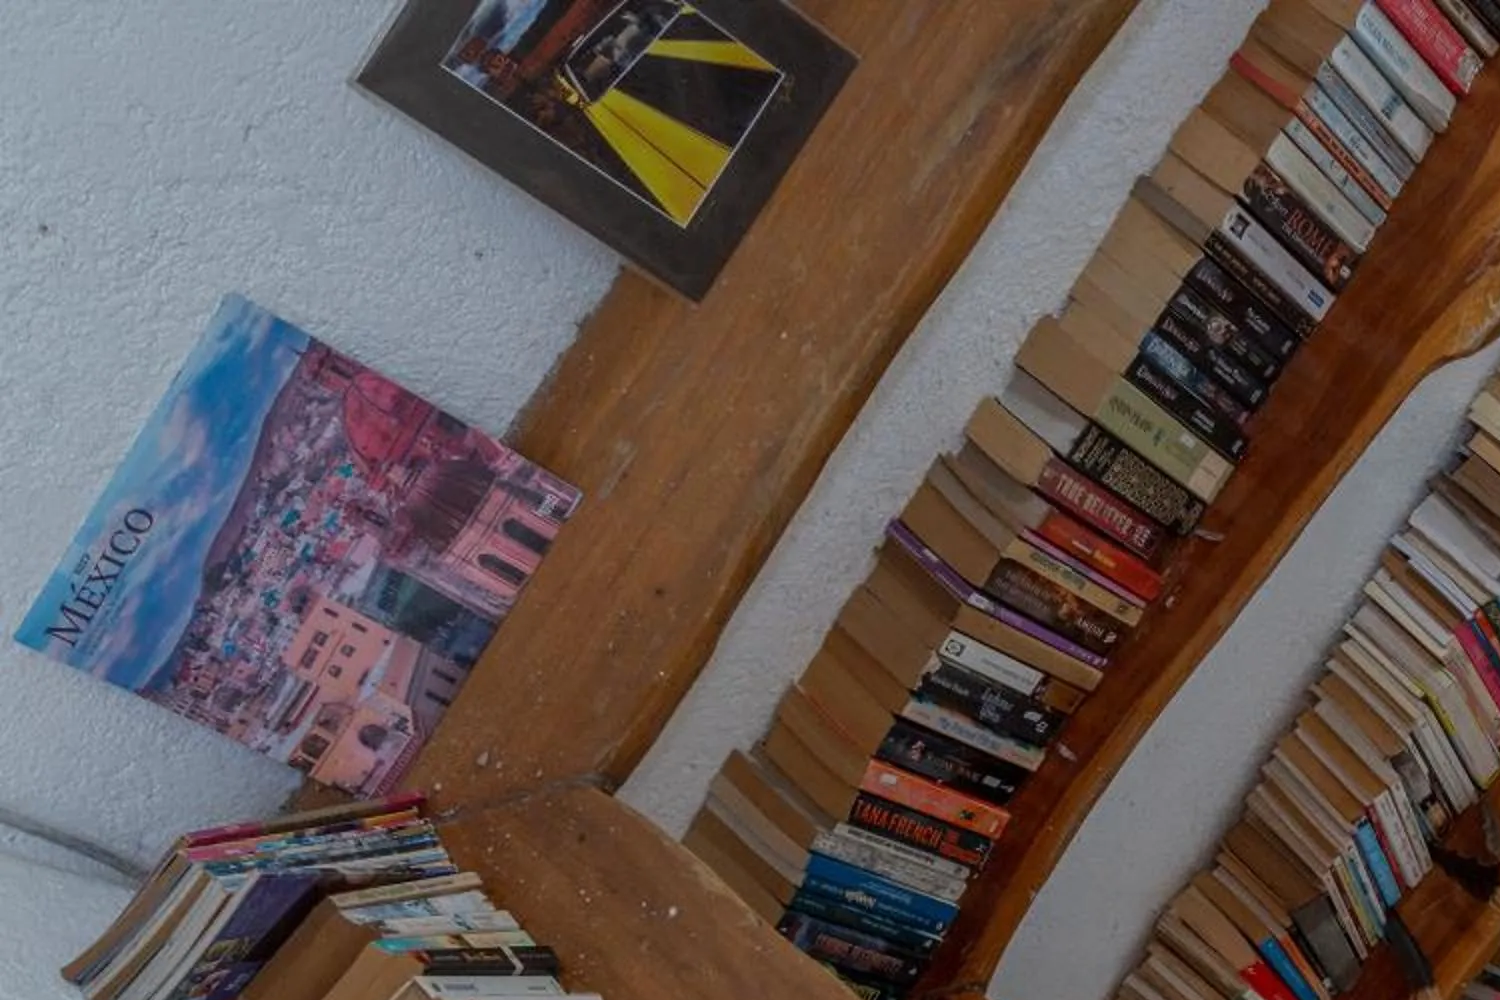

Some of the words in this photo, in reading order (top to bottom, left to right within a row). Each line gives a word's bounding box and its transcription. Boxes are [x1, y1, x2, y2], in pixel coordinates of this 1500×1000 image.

[44, 508, 154, 648] MÉXICO
[855, 799, 889, 829] TANA
[887, 813, 943, 849] FRENCH
